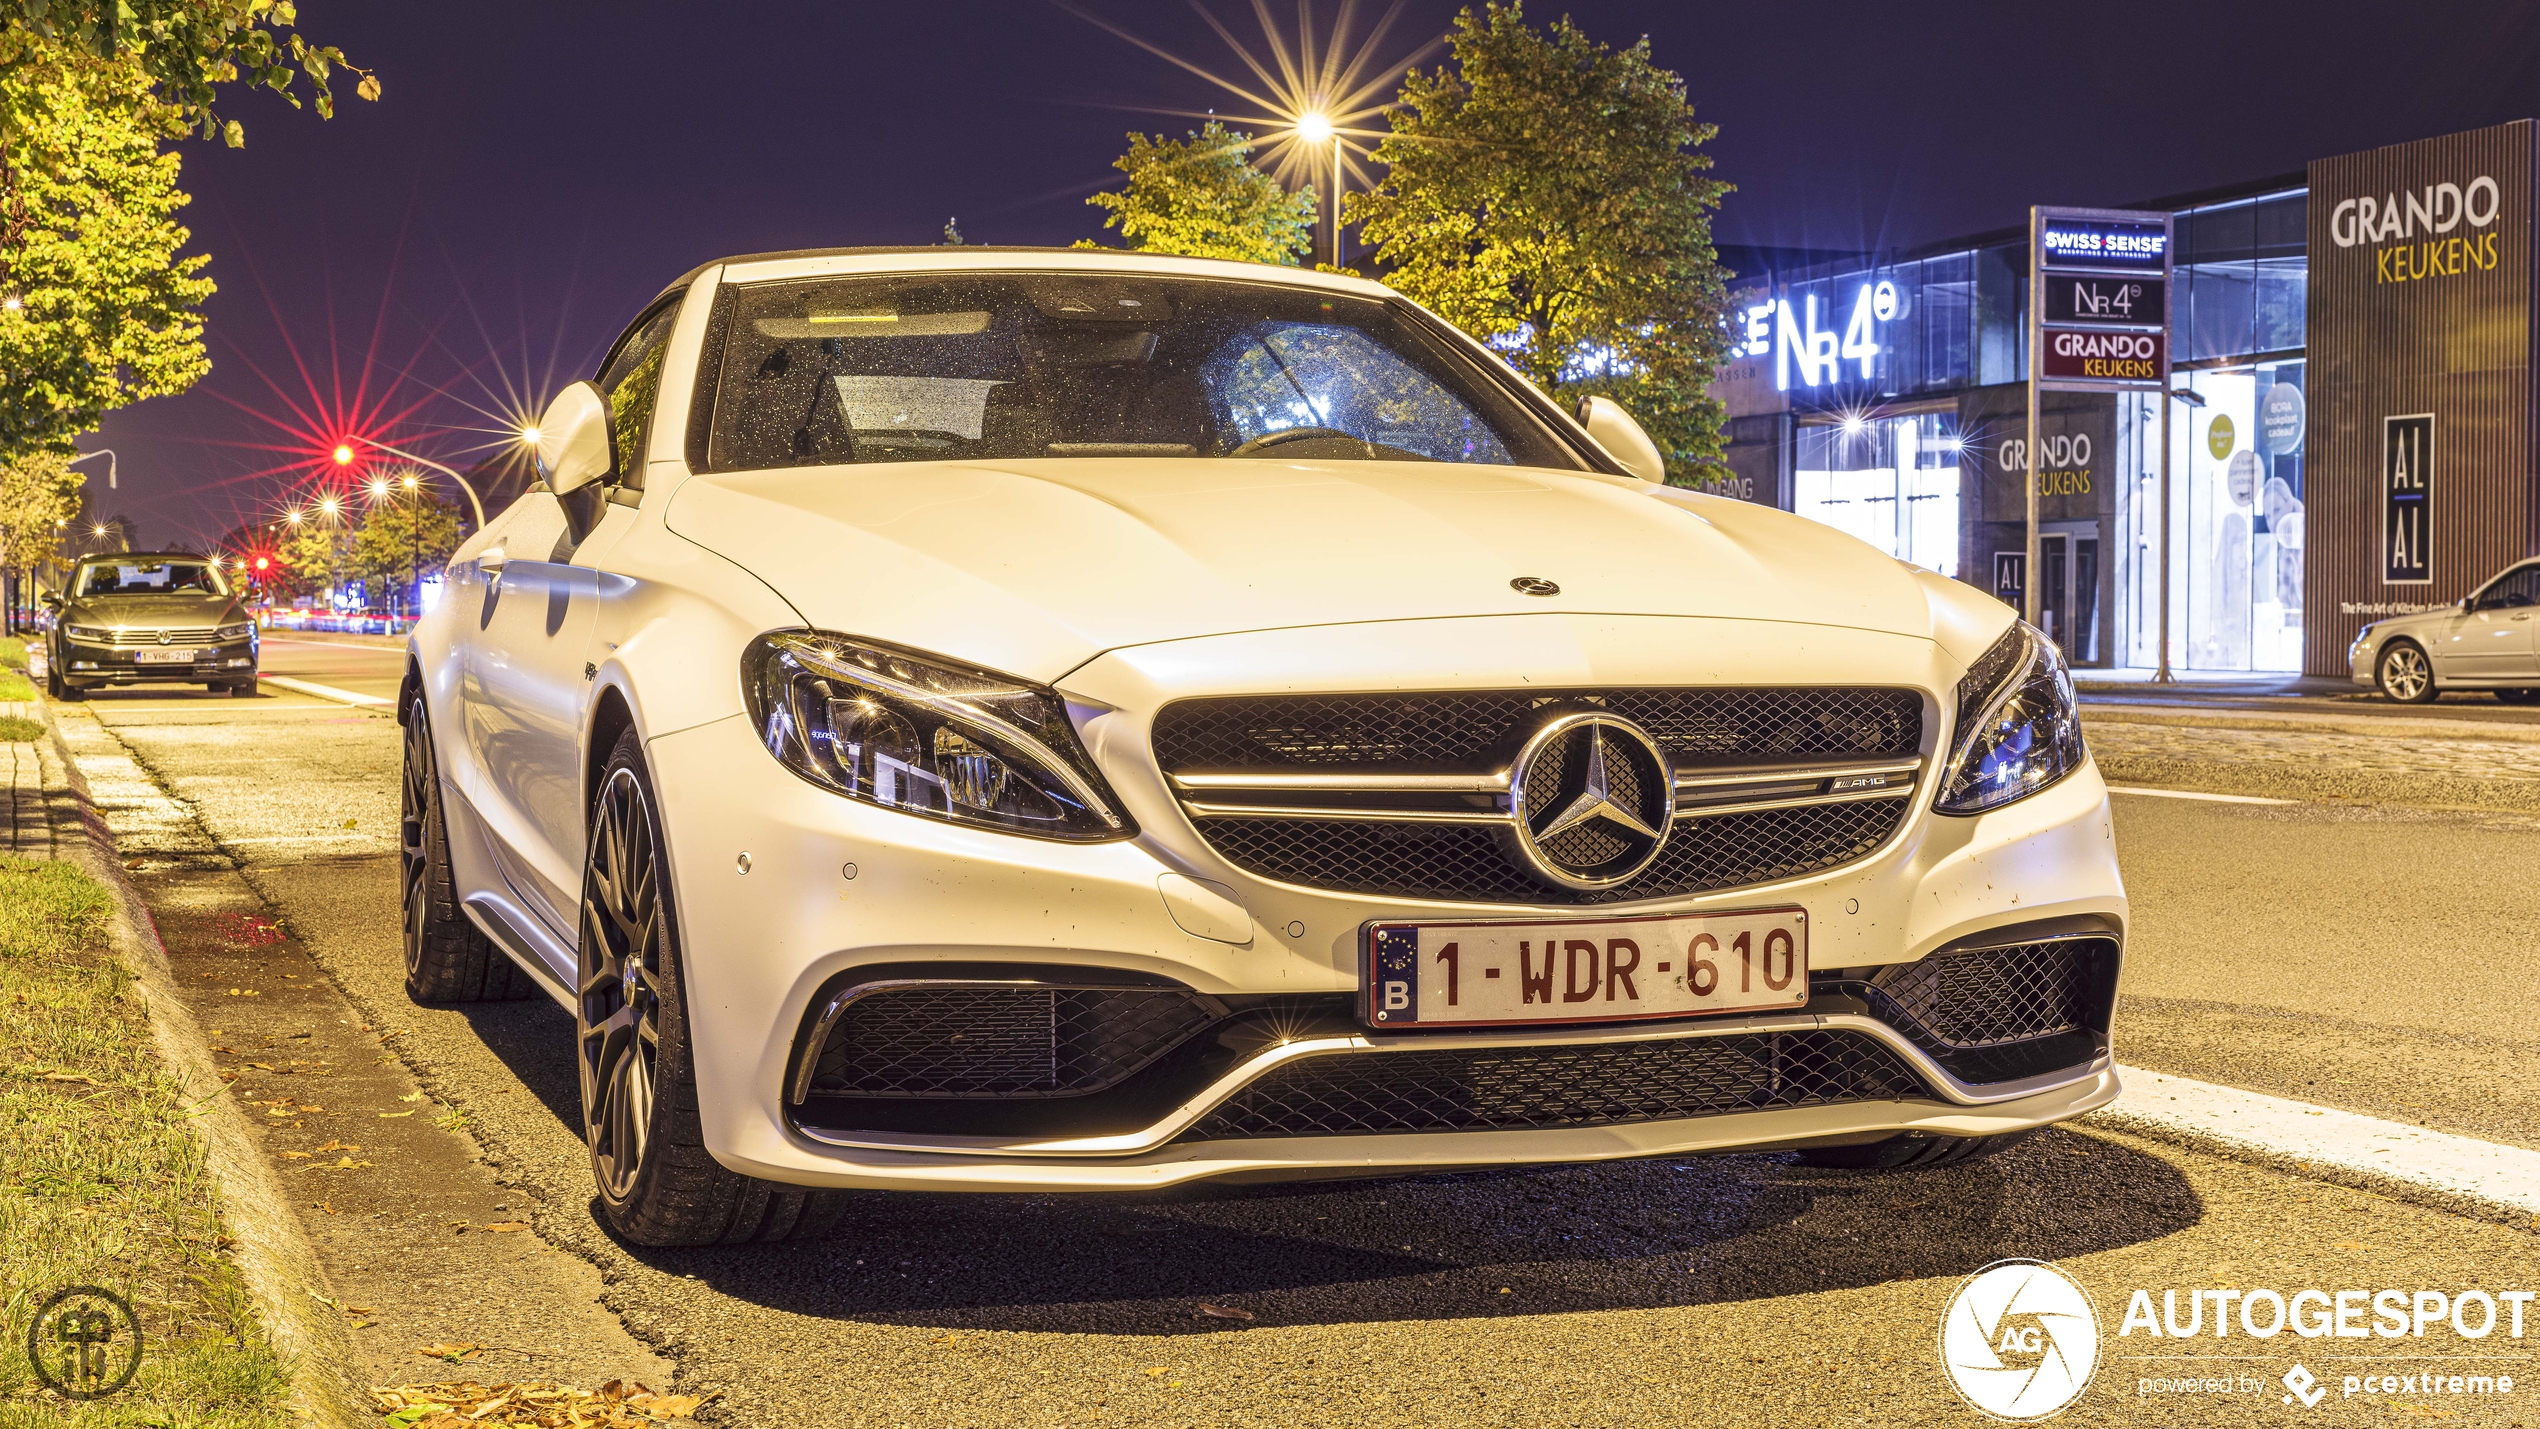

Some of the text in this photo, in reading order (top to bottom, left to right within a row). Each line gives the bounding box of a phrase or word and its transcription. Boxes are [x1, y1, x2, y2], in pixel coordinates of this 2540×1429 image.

[2331, 175, 2500, 248] GRANDO
[2045, 231, 2101, 250] SWISS
[2377, 232, 2498, 284] KEUKENS
[2055, 333, 2155, 359] GRANDO
[2084, 359, 2154, 378] KEUKENS
[1999, 433, 2092, 472] GRNDO
[2394, 426, 2424, 489] AL
[1706, 477, 1753, 499] INGANG
[2026, 470, 2091, 497] EUKENS
[2393, 506, 2423, 569] AL
[2001, 558, 2021, 590] AL
[2341, 602, 2356, 614] The
[2356, 602, 2373, 614] Fine
[2373, 602, 2386, 614] Art
[2387, 601, 2397, 616] of
[2396, 602, 2426, 615] Kitchen
[1850, 776, 1885, 788] AMG
[1385, 981, 1409, 1010] B
